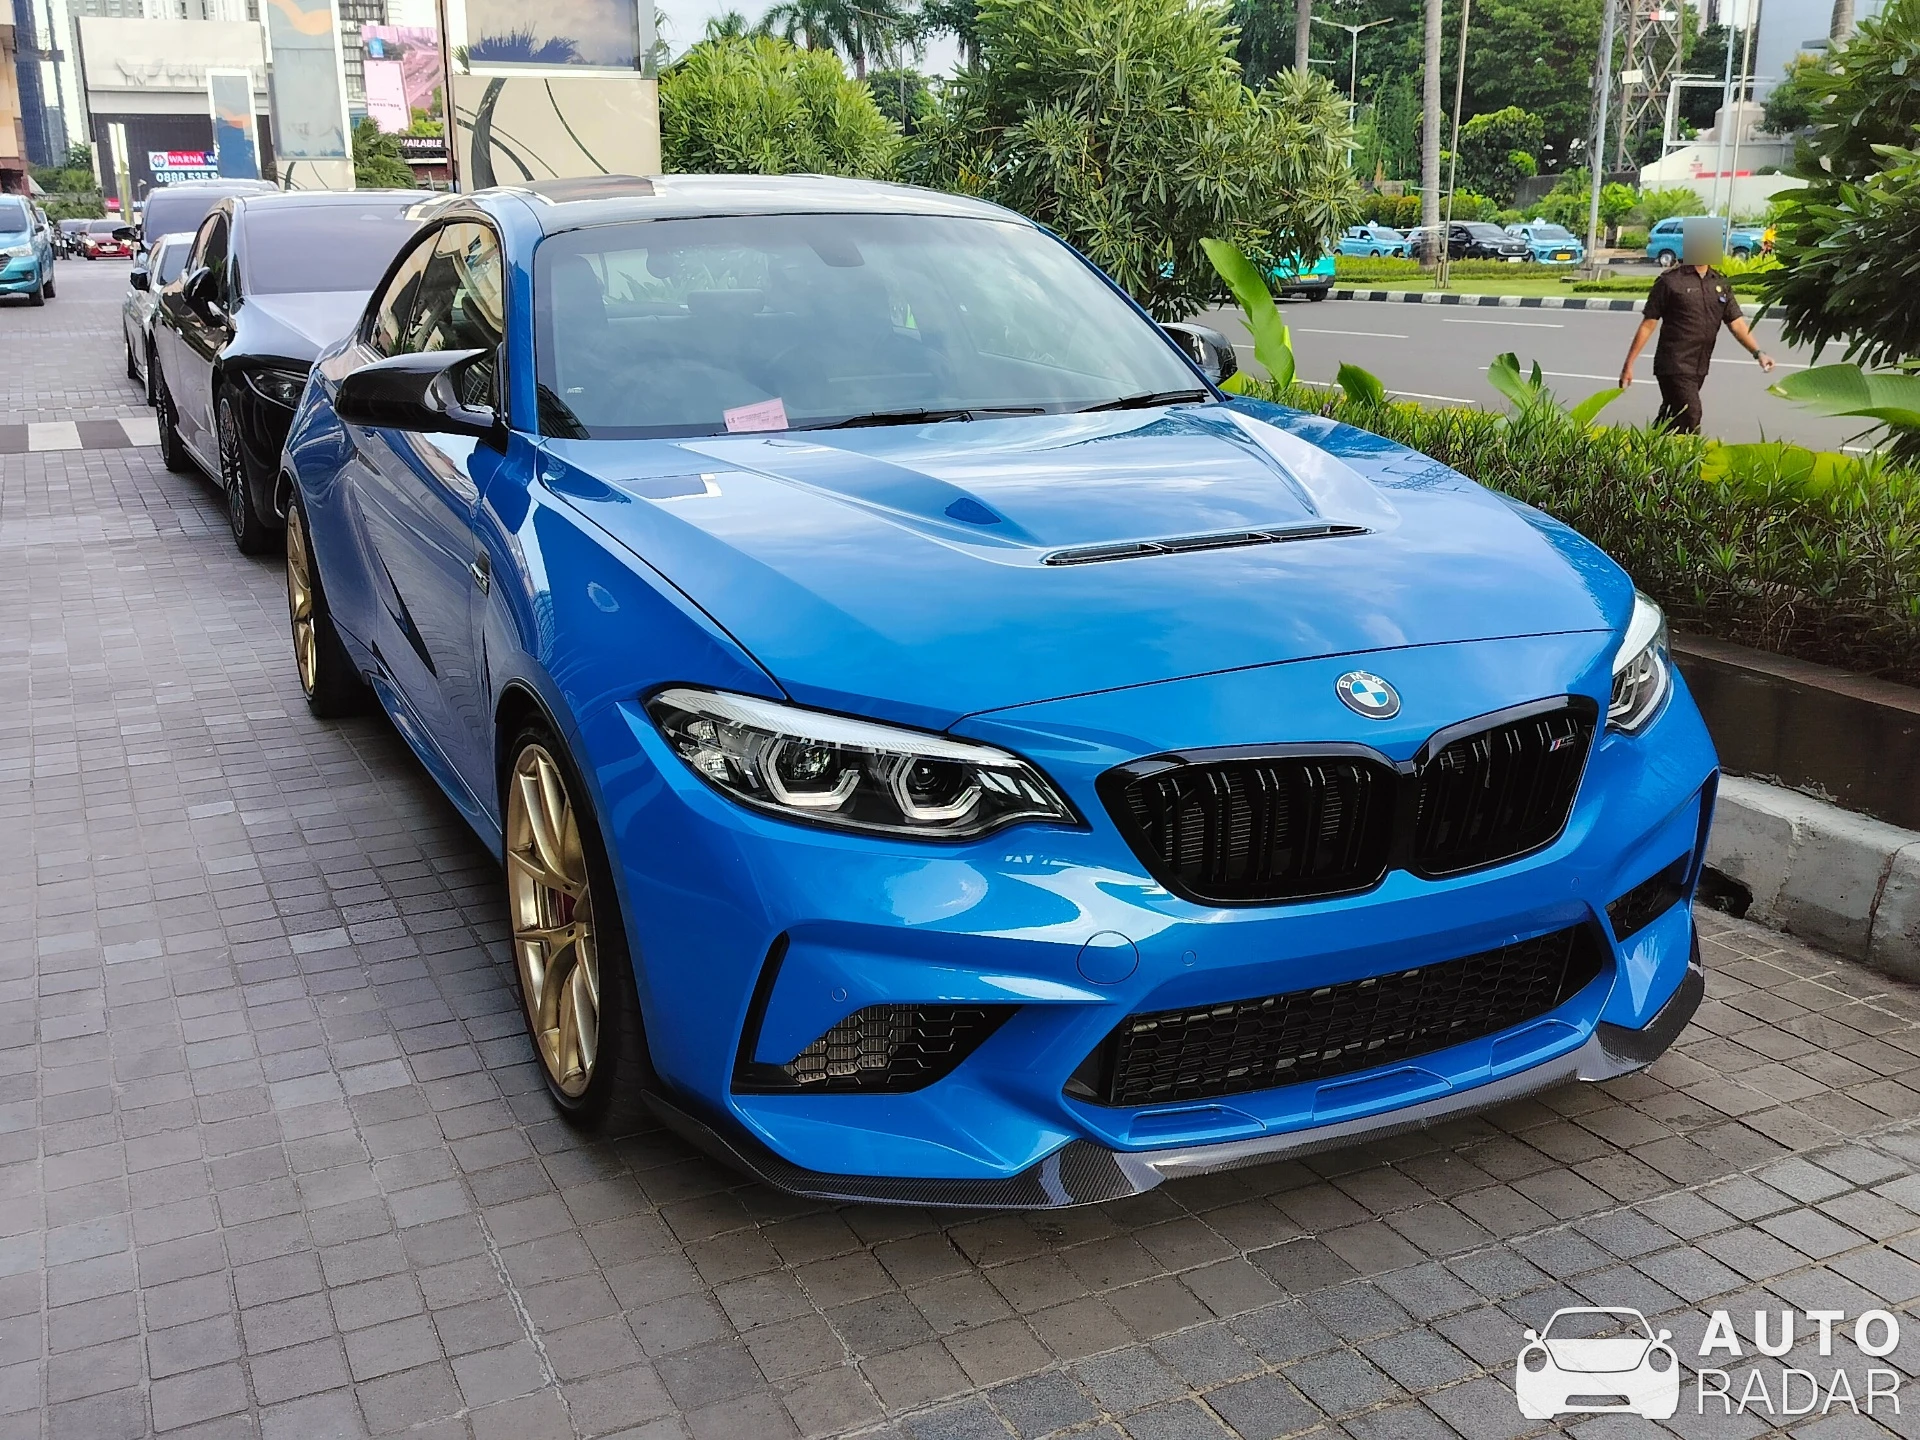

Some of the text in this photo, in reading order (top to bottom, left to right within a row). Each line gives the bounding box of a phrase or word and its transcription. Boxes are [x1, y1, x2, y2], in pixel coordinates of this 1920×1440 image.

[401, 139, 442, 147] VAILABLE
[168, 155, 204, 164] WARNA
[156, 171, 186, 183] 0888
[1340, 669, 1384, 689] BMW
